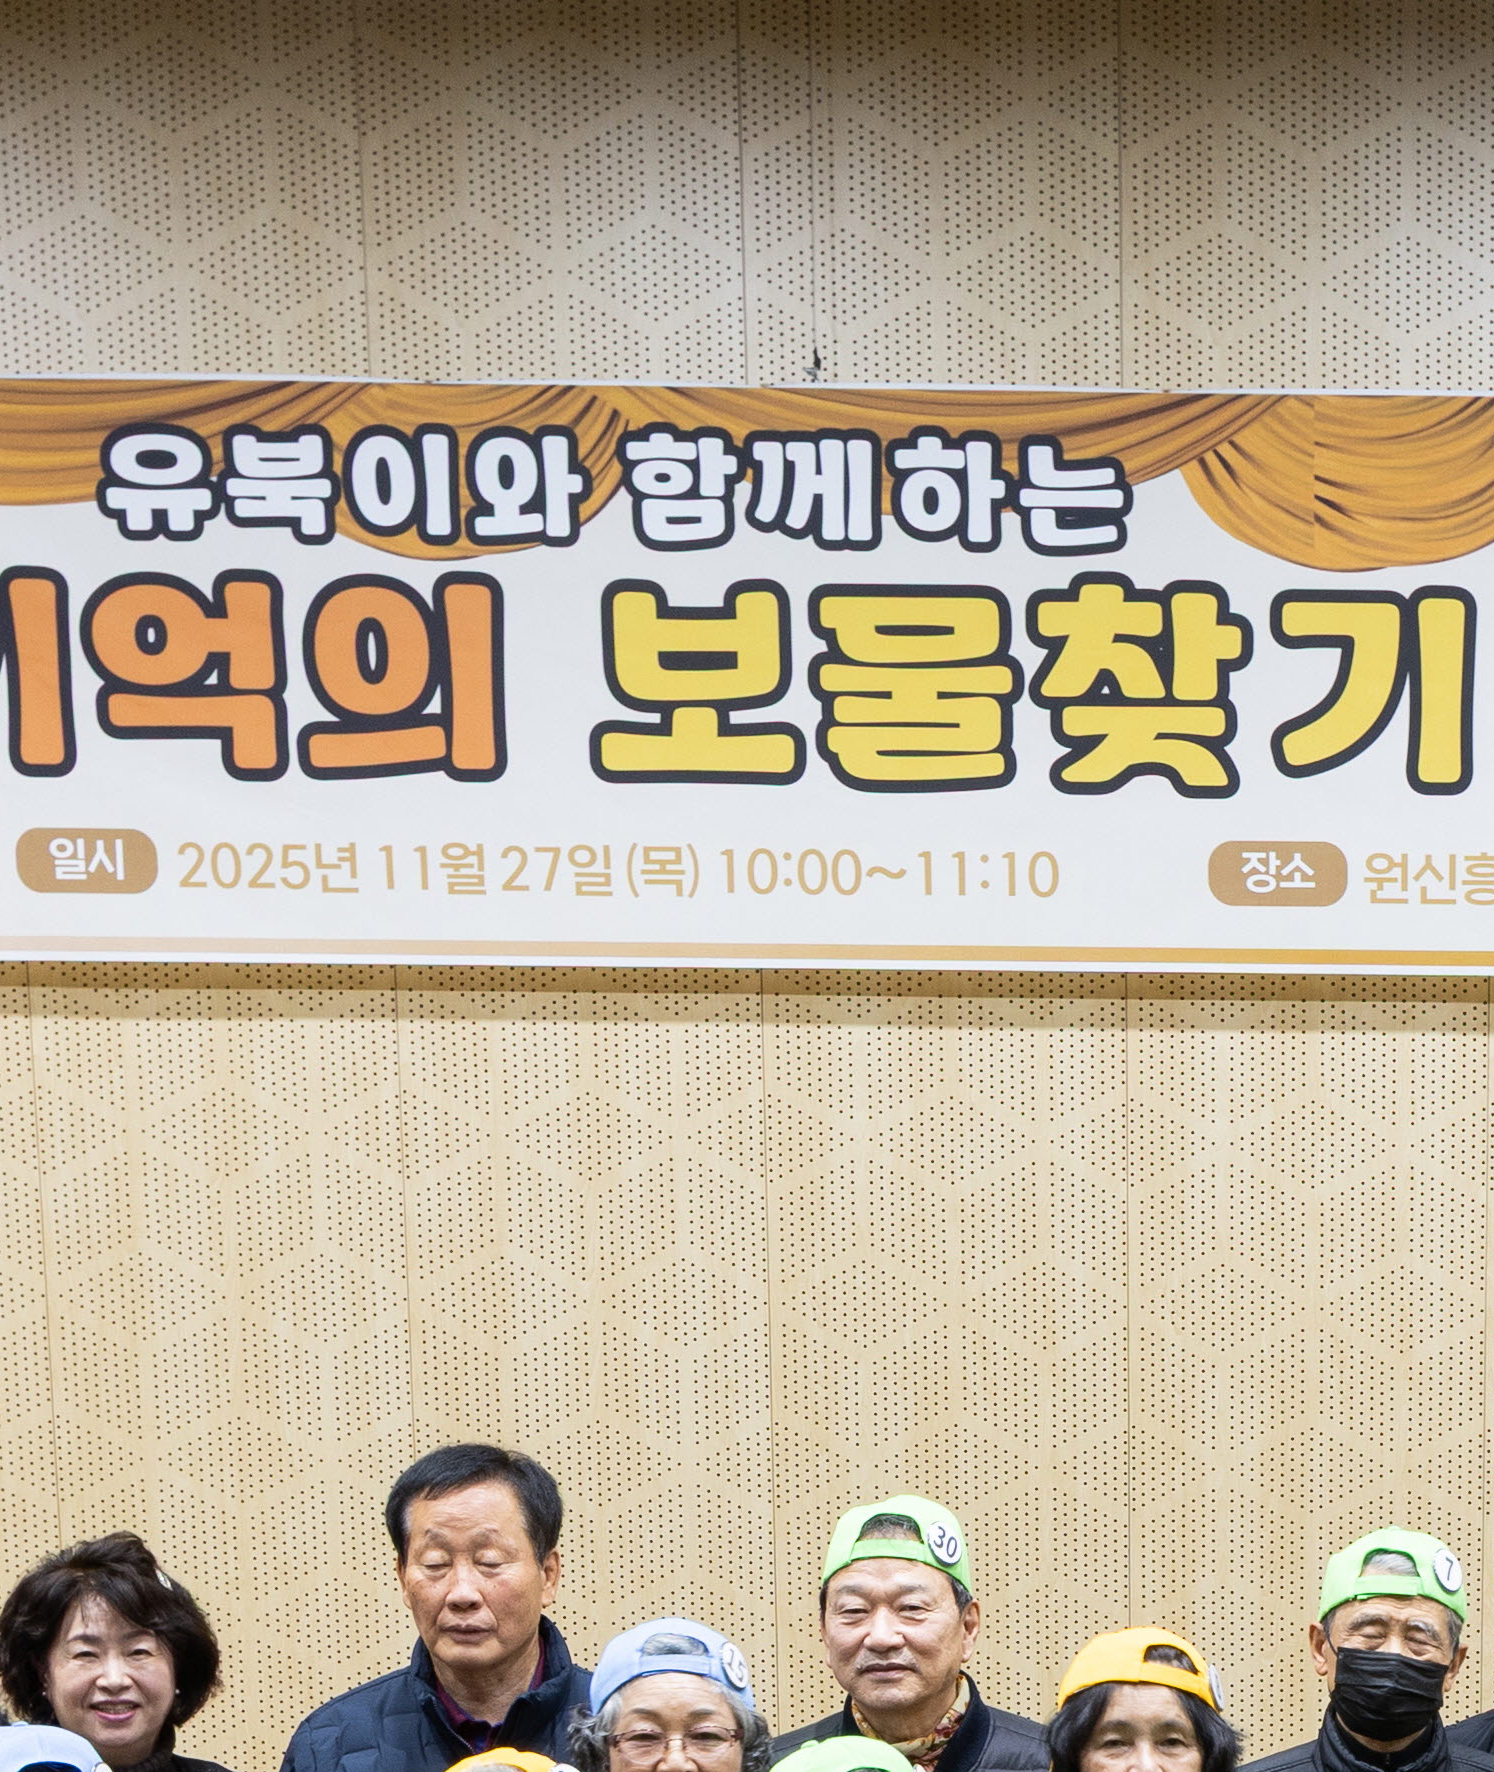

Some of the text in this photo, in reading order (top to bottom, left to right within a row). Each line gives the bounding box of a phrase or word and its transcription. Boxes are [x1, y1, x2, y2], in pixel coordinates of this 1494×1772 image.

[97, 422, 1132, 555] 유북이와 함께하는
[589, 571, 1476, 798] 보물찾기
[47, 836, 125, 882] 일시
[178, 840, 1059, 900] 2025년 11월 27일(목) 10:00~11:10
[1241, 850, 1317, 893] 장소
[937, 1526, 959, 1556] 30
